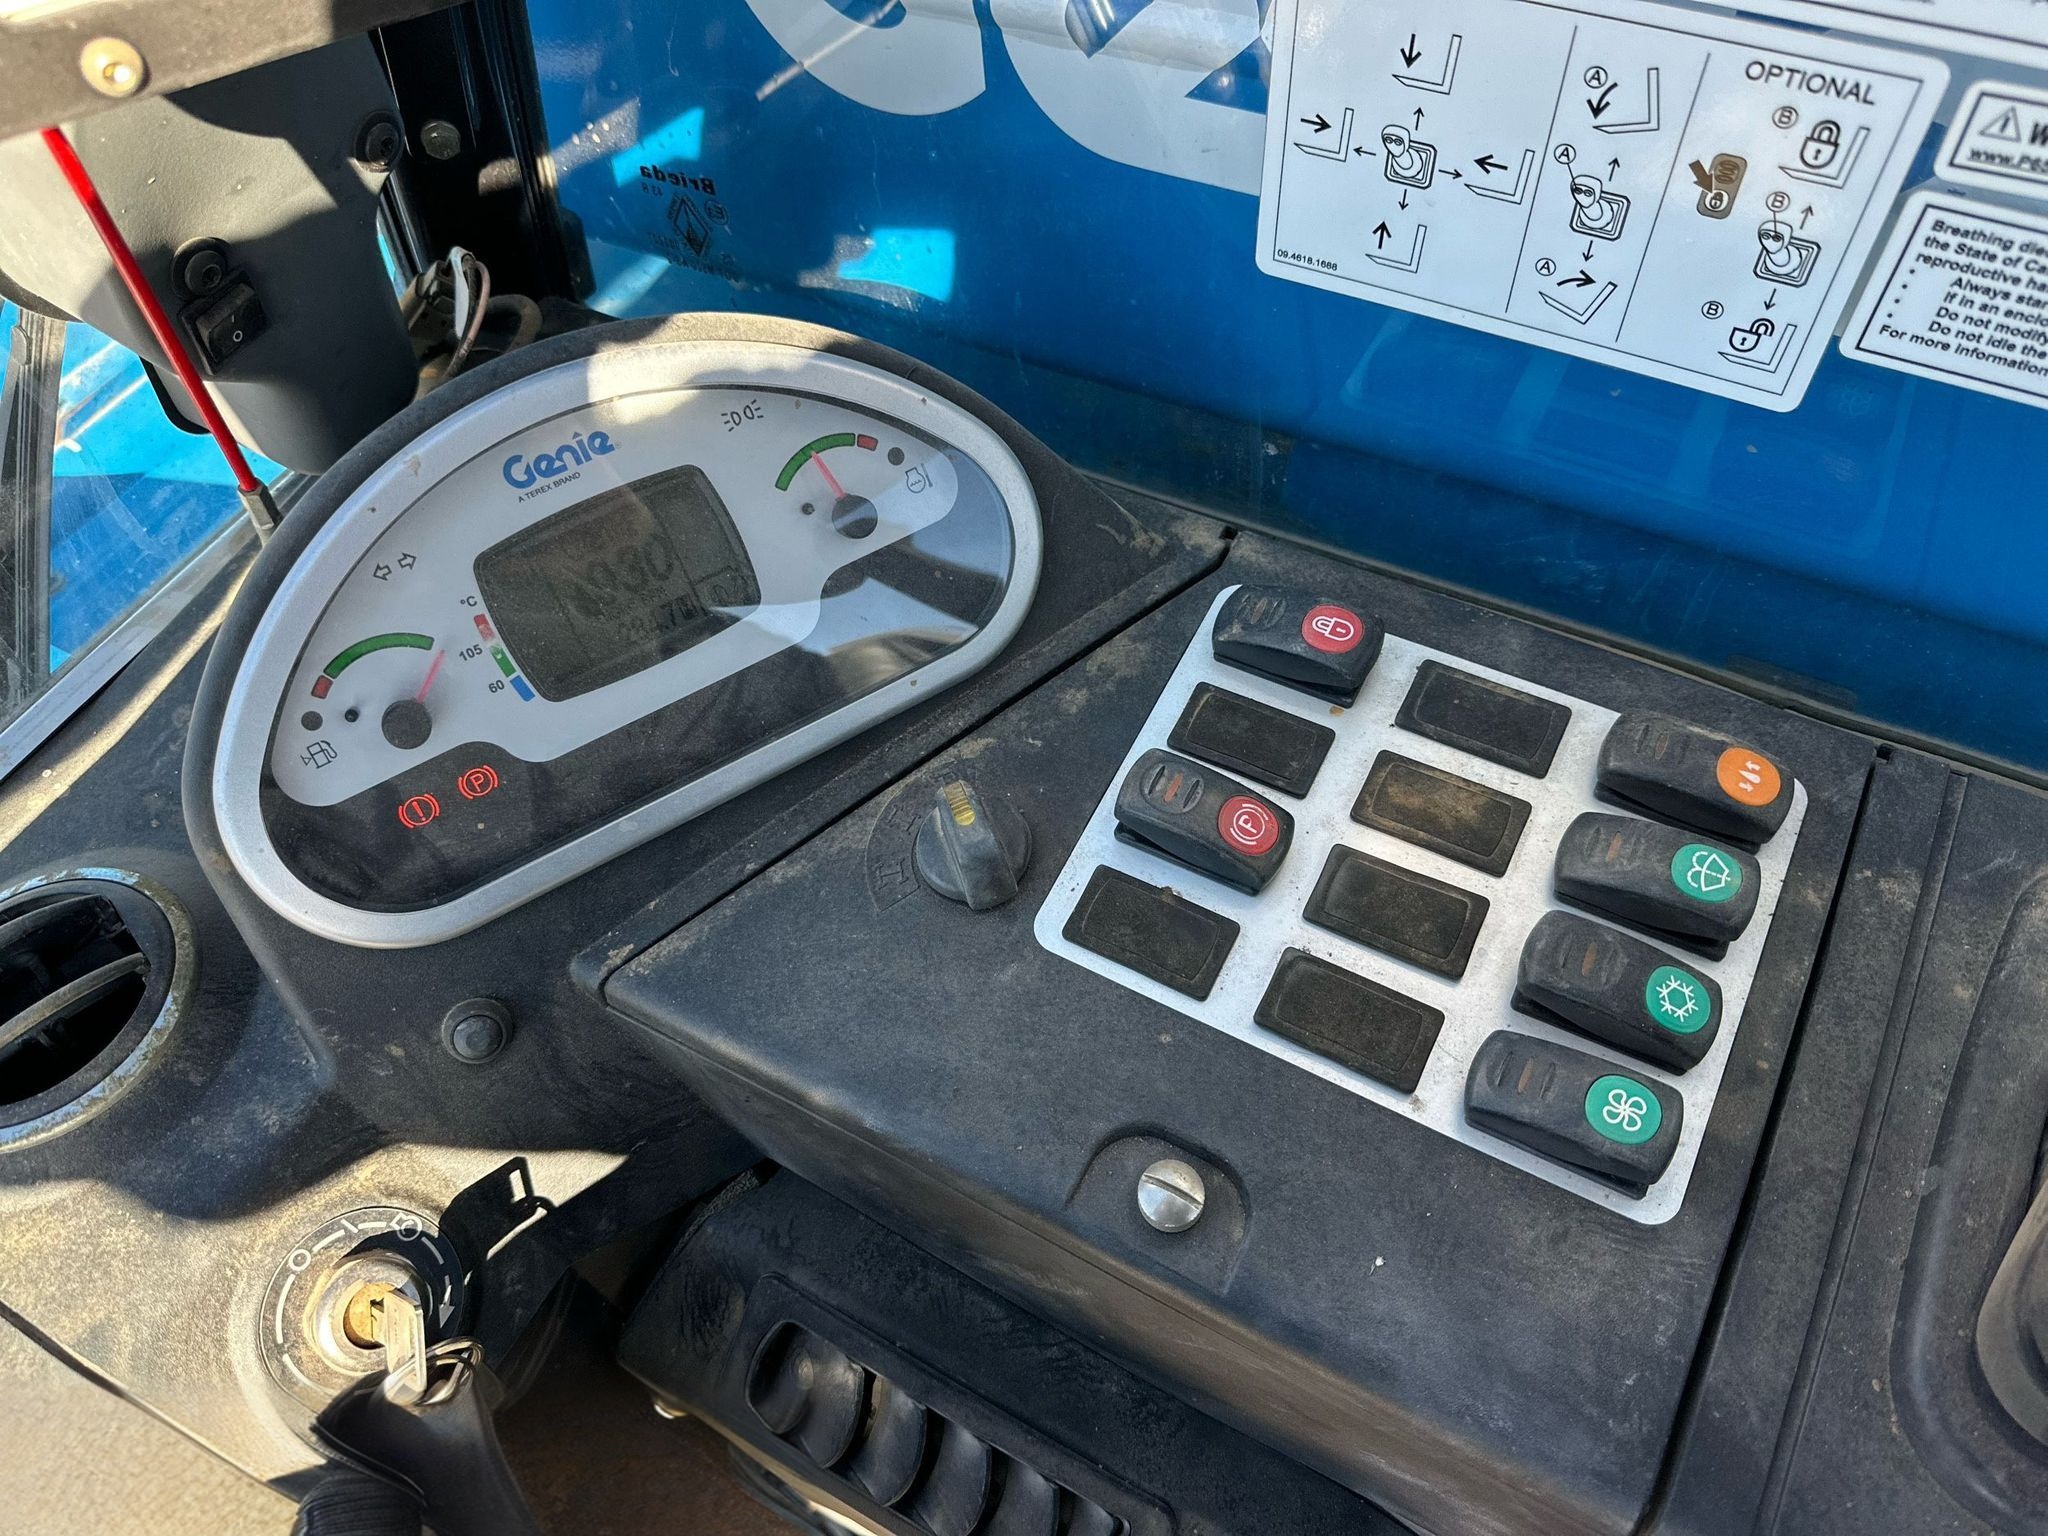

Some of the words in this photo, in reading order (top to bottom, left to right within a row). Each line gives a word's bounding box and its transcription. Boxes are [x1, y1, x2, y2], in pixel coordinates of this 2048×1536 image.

[1745, 60, 1876, 106] OPTIONAL
[1931, 219, 2015, 251] Breathing
[1923, 235, 1951, 252] the
[1954, 242, 1998, 263] State
[2001, 255, 2023, 268] of
[1914, 252, 2023, 287] reproductive
[1943, 291, 1959, 304] If
[1958, 294, 1976, 309] in
[1978, 302, 2000, 316] an
[1950, 276, 2012, 301] Always
[1935, 305, 1960, 321] Do
[1962, 314, 1992, 330] not
[1879, 323, 1908, 339] For
[1909, 333, 1952, 352] more
[1953, 342, 2048, 378] information
[1928, 320, 1952, 336] Do
[1954, 328, 1984, 345] not
[1985, 335, 2017, 352] idle
[2020, 343, 2048, 360] the
[524, 484, 553, 500] TEREX
[552, 471, 581, 489] BRAND
[458, 643, 484, 662] 105
[488, 679, 506, 694] 60
